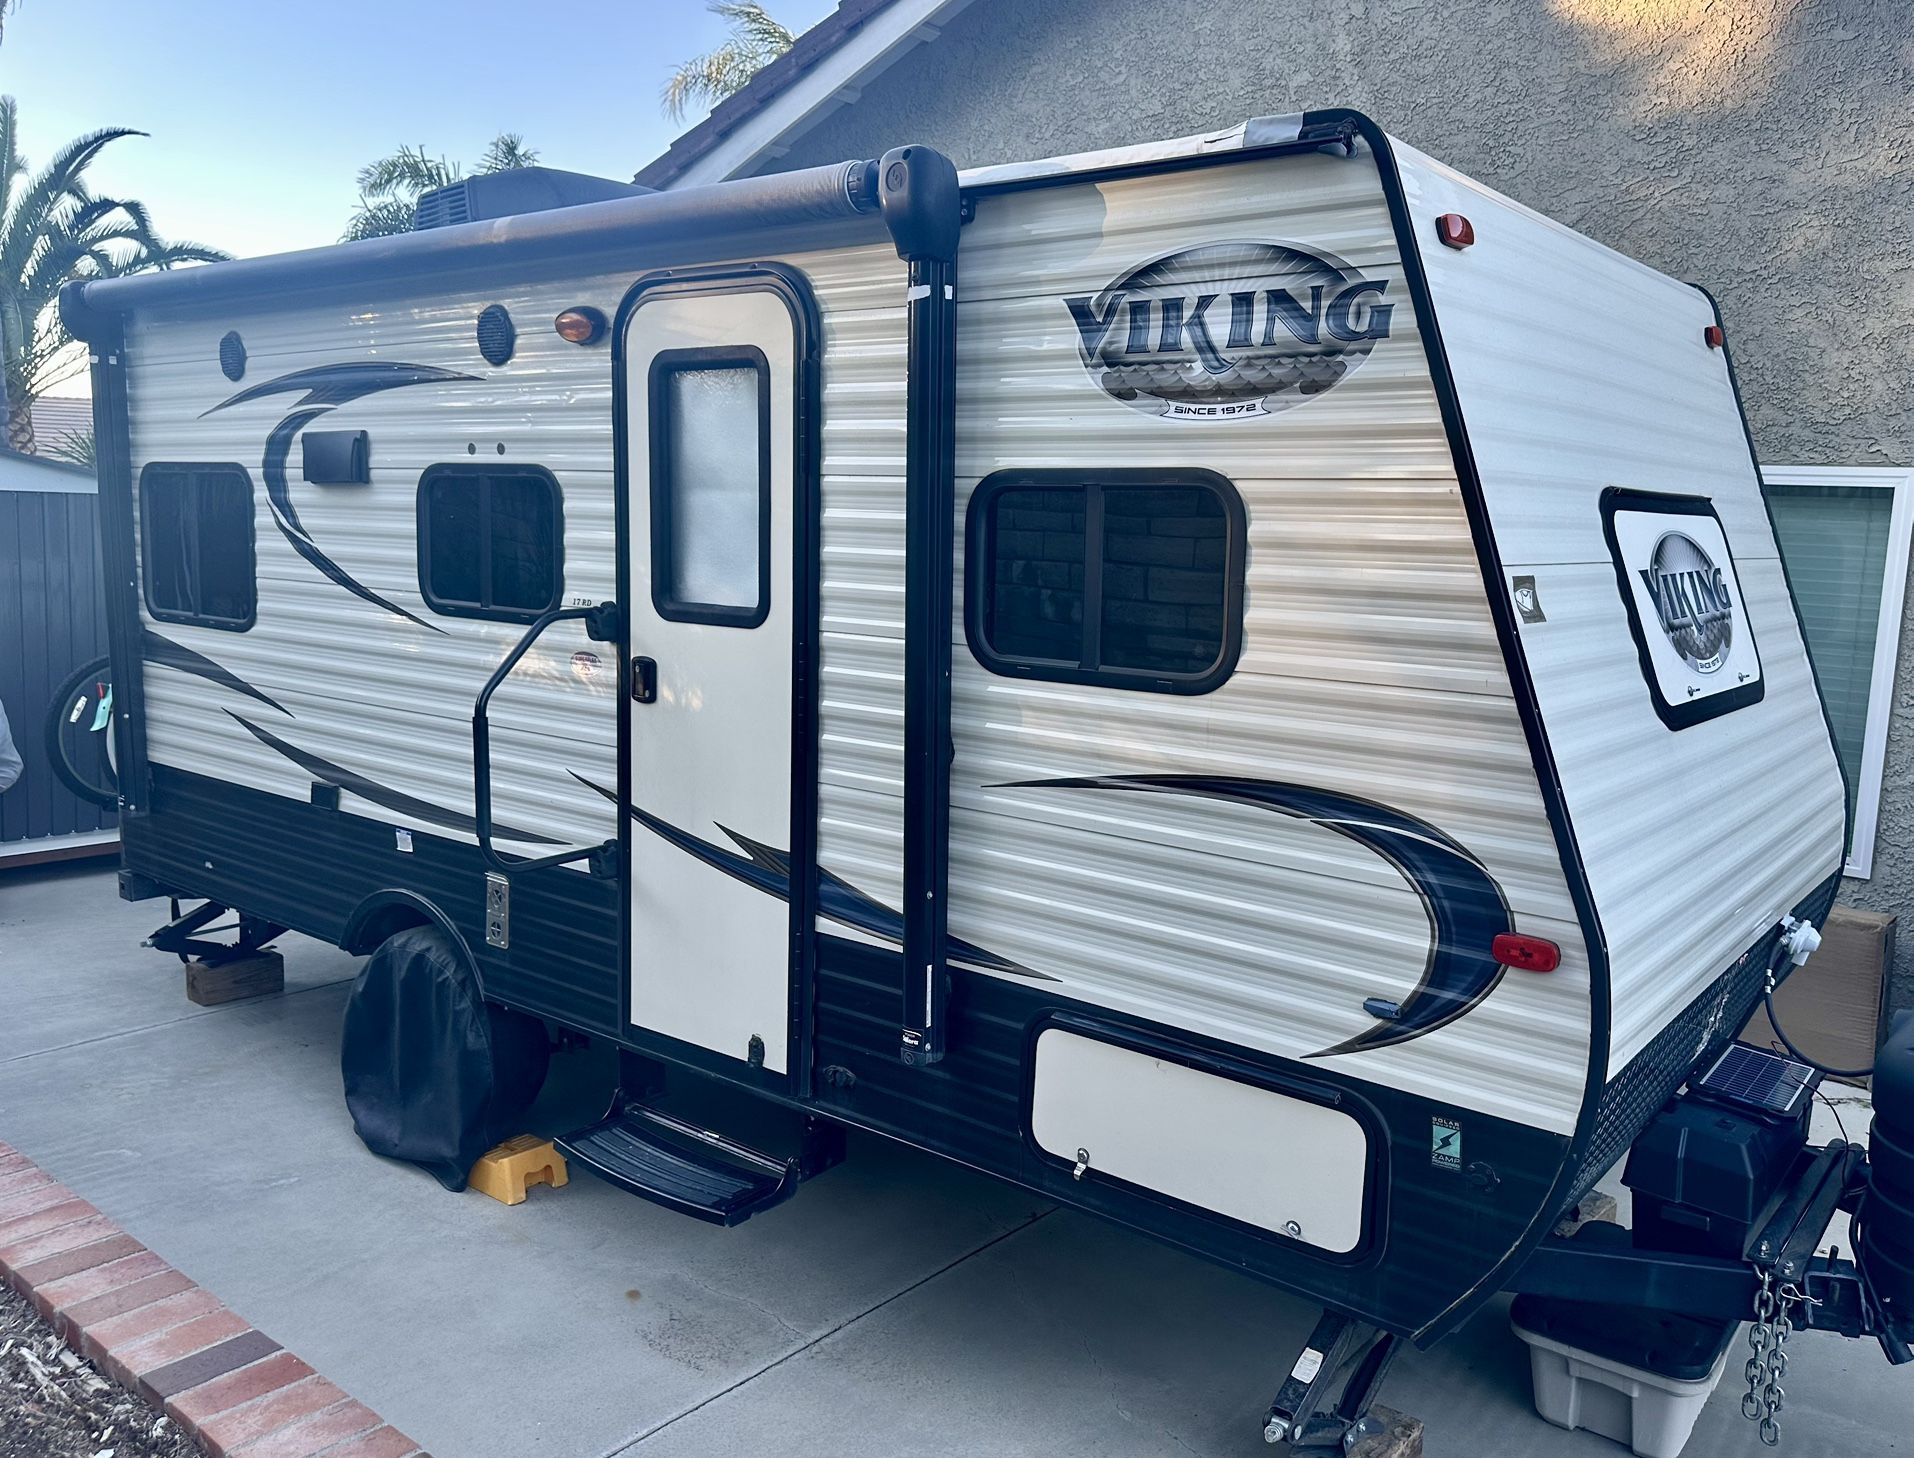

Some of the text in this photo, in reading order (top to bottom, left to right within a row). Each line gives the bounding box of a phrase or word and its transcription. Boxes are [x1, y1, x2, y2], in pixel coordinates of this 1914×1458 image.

[1063, 279, 1396, 375] VIKING
[1174, 403, 1256, 415] SINCE 1972
[1638, 567, 1732, 635] VIKING
[1432, 1116, 1460, 1127] SOLAR
[1432, 1152, 1460, 1164] ZAMP
